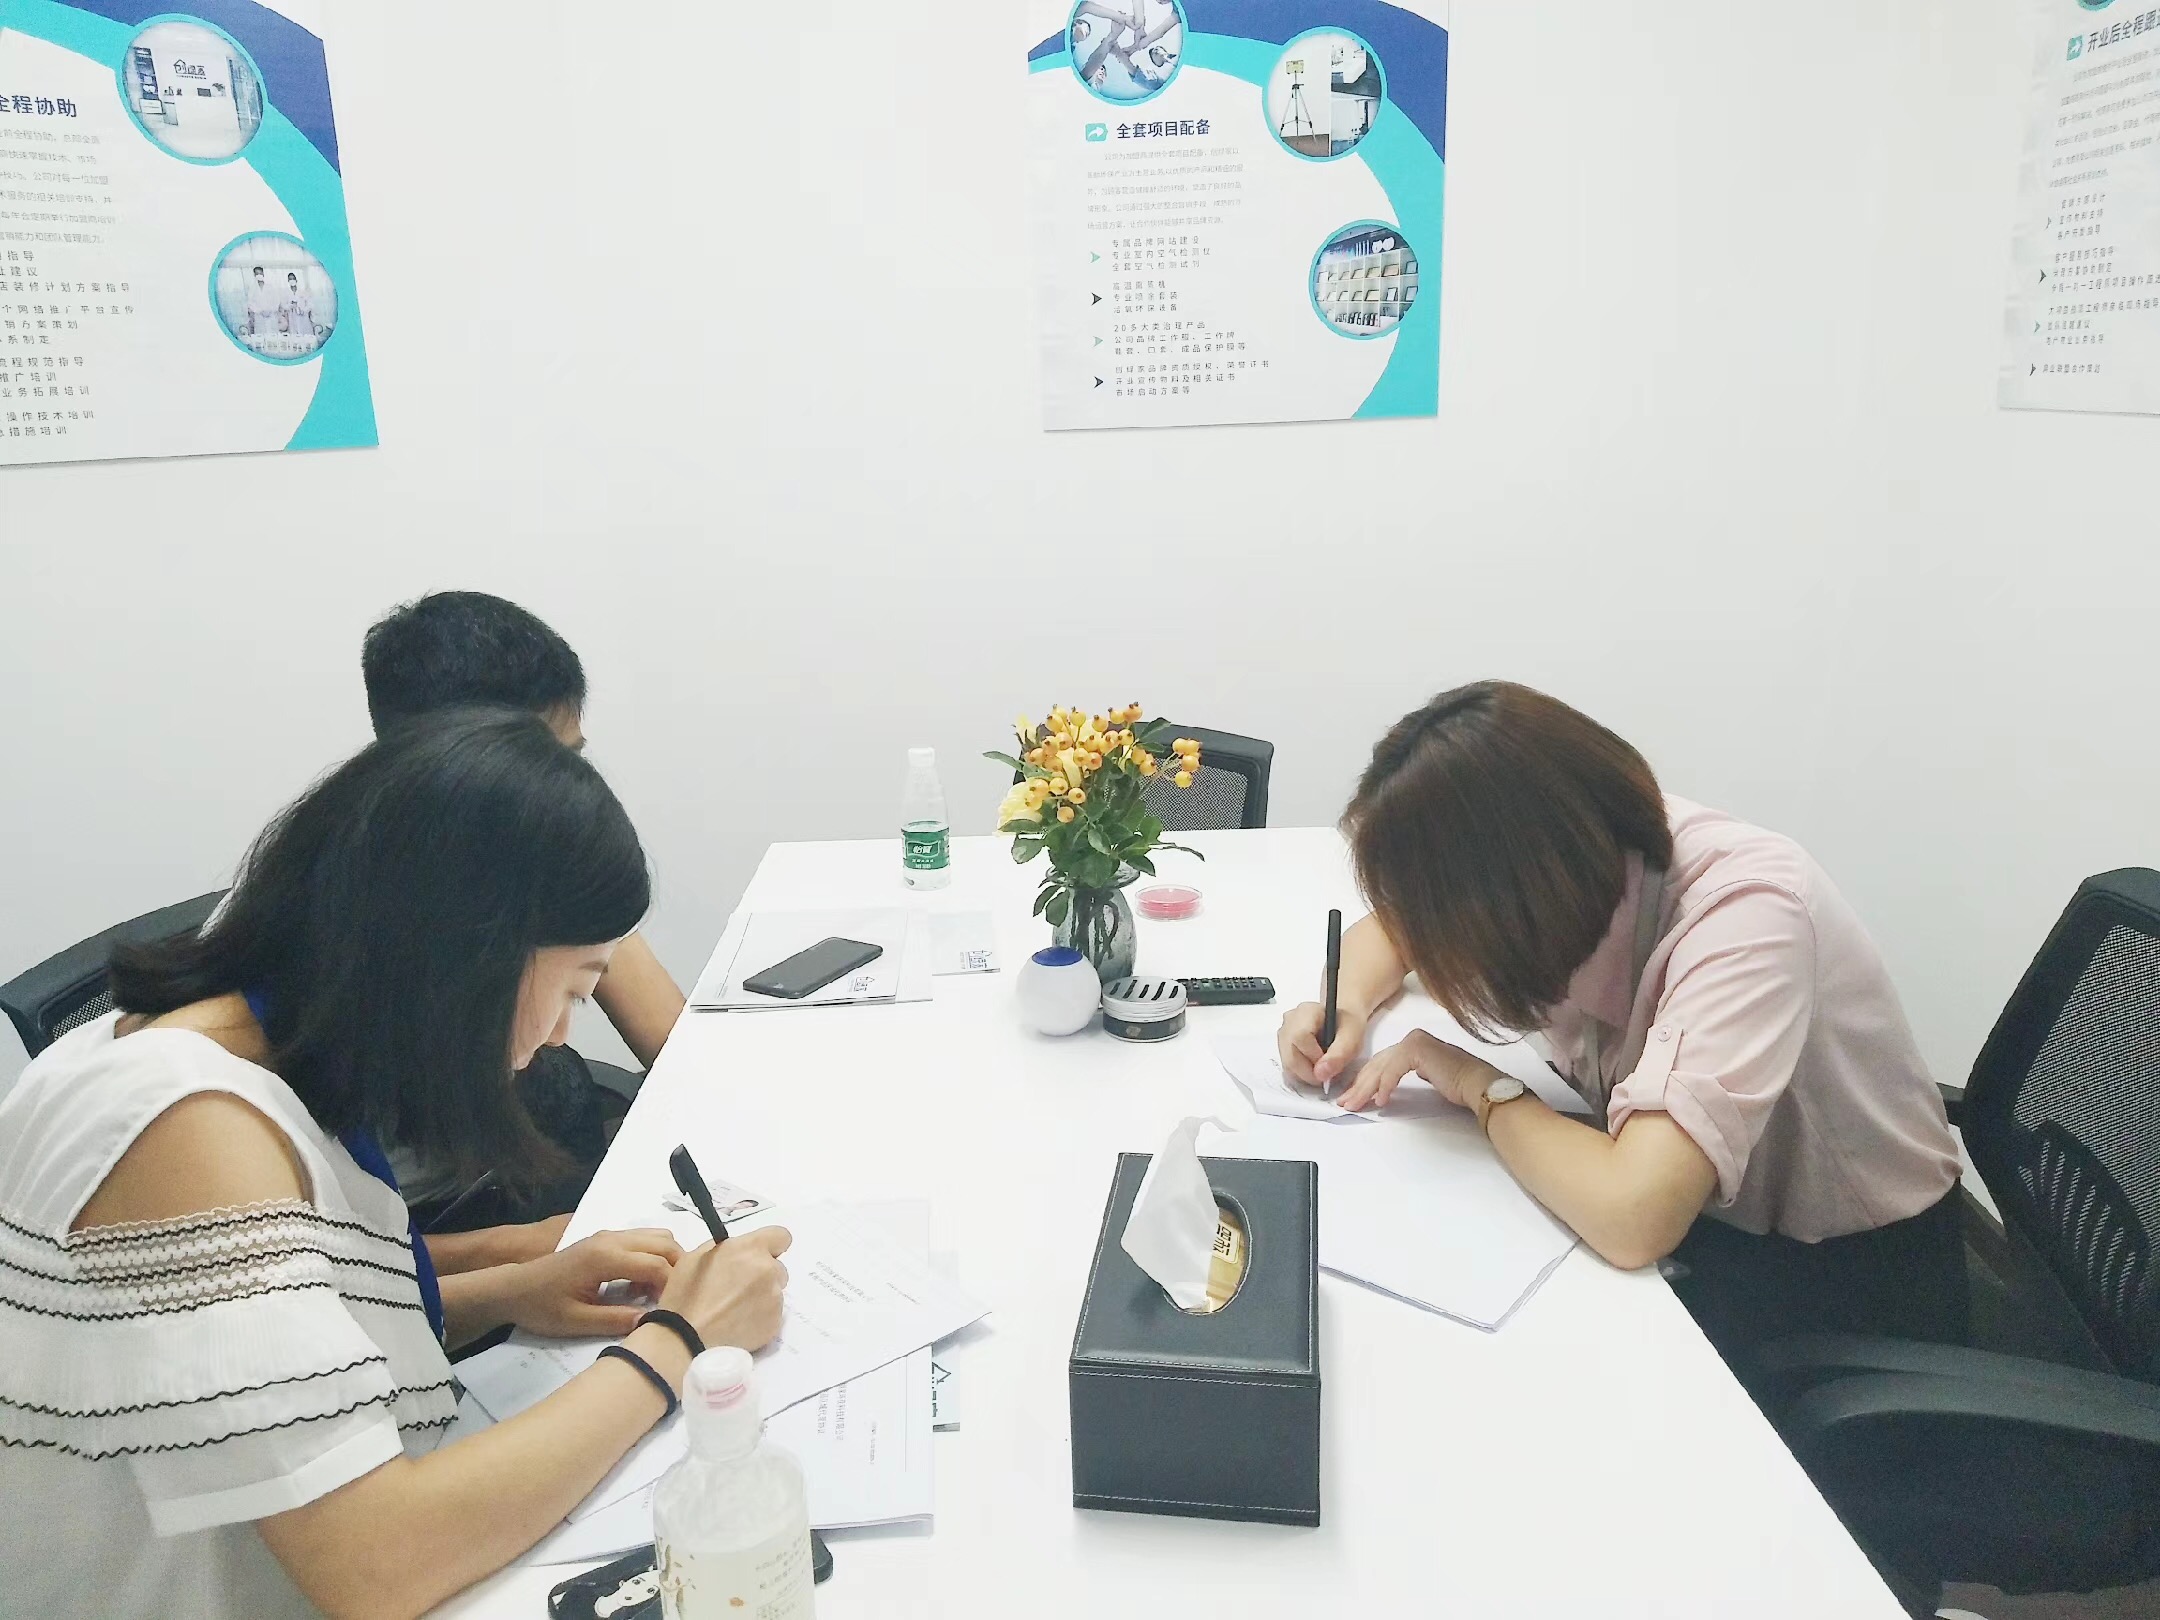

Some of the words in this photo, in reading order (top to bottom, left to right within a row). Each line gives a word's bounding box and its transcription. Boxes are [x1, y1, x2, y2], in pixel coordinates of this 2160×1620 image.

[1116, 118, 1211, 140] 全套项目配备
[0, 250, 35, 262] 指导
[0, 335, 50, 345] 系制定
[2, 386, 90, 398] 业务拓展培训
